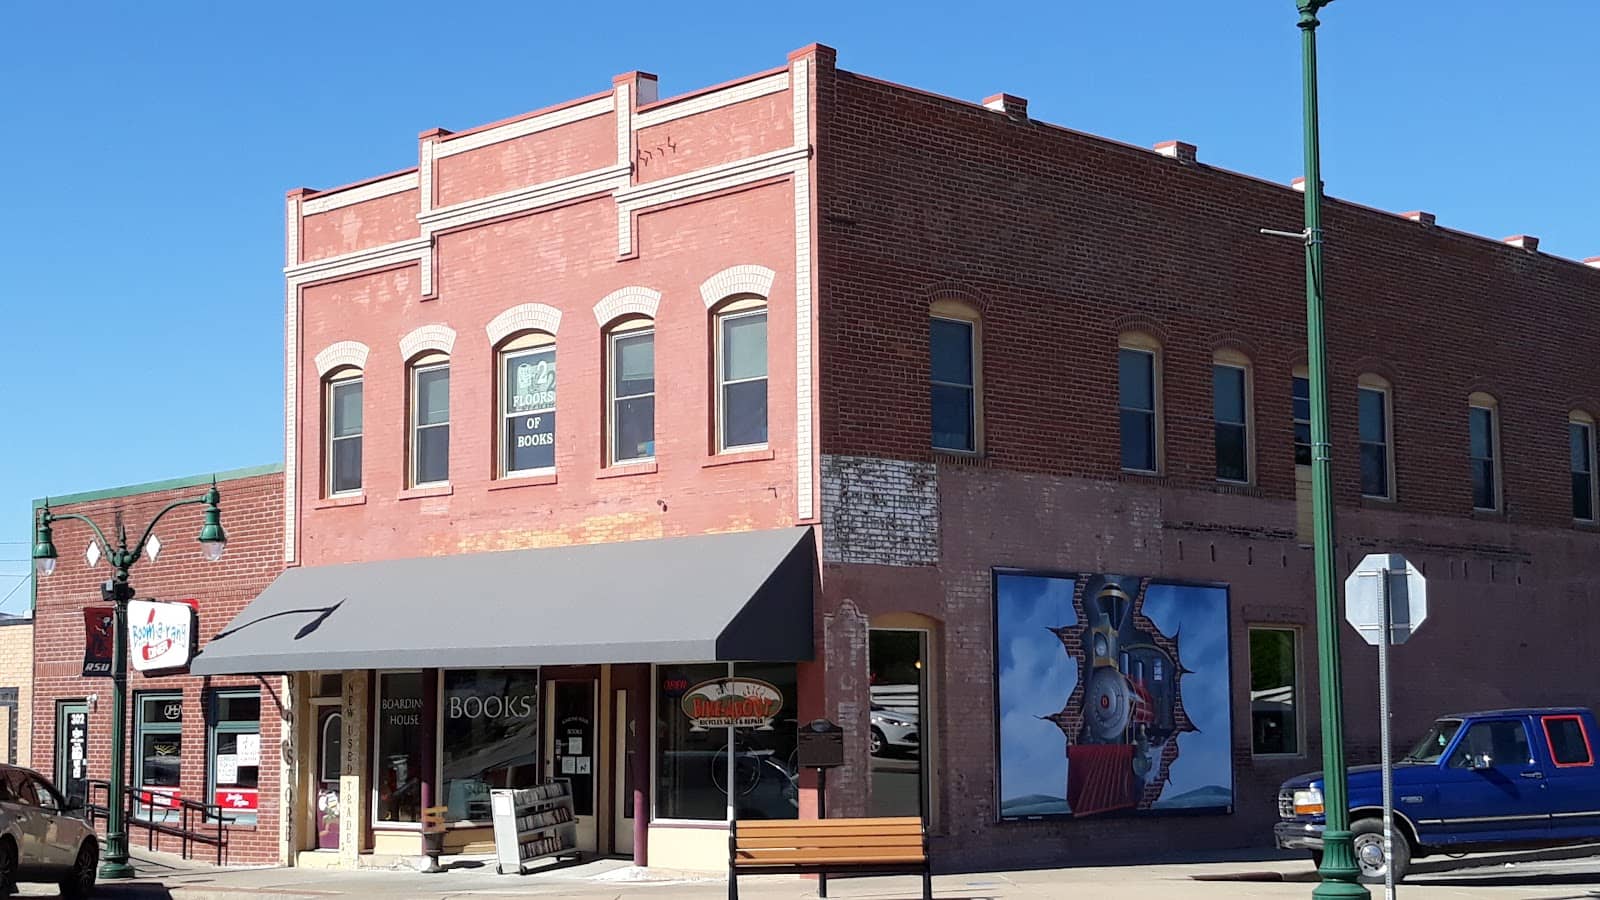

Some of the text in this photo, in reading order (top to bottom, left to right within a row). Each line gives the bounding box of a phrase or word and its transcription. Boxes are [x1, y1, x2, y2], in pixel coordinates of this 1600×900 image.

[512, 391, 554, 408] FLOORS
[526, 417, 542, 430] OF
[517, 433, 553, 448] BOOKS
[84, 662, 110, 672] RSU
[382, 698, 424, 710] BOARDIN
[449, 695, 531, 719] BOOKS
[70, 713, 85, 725] 302
[390, 714, 420, 726] HOUSE
[344, 781, 353, 844] TRADE
